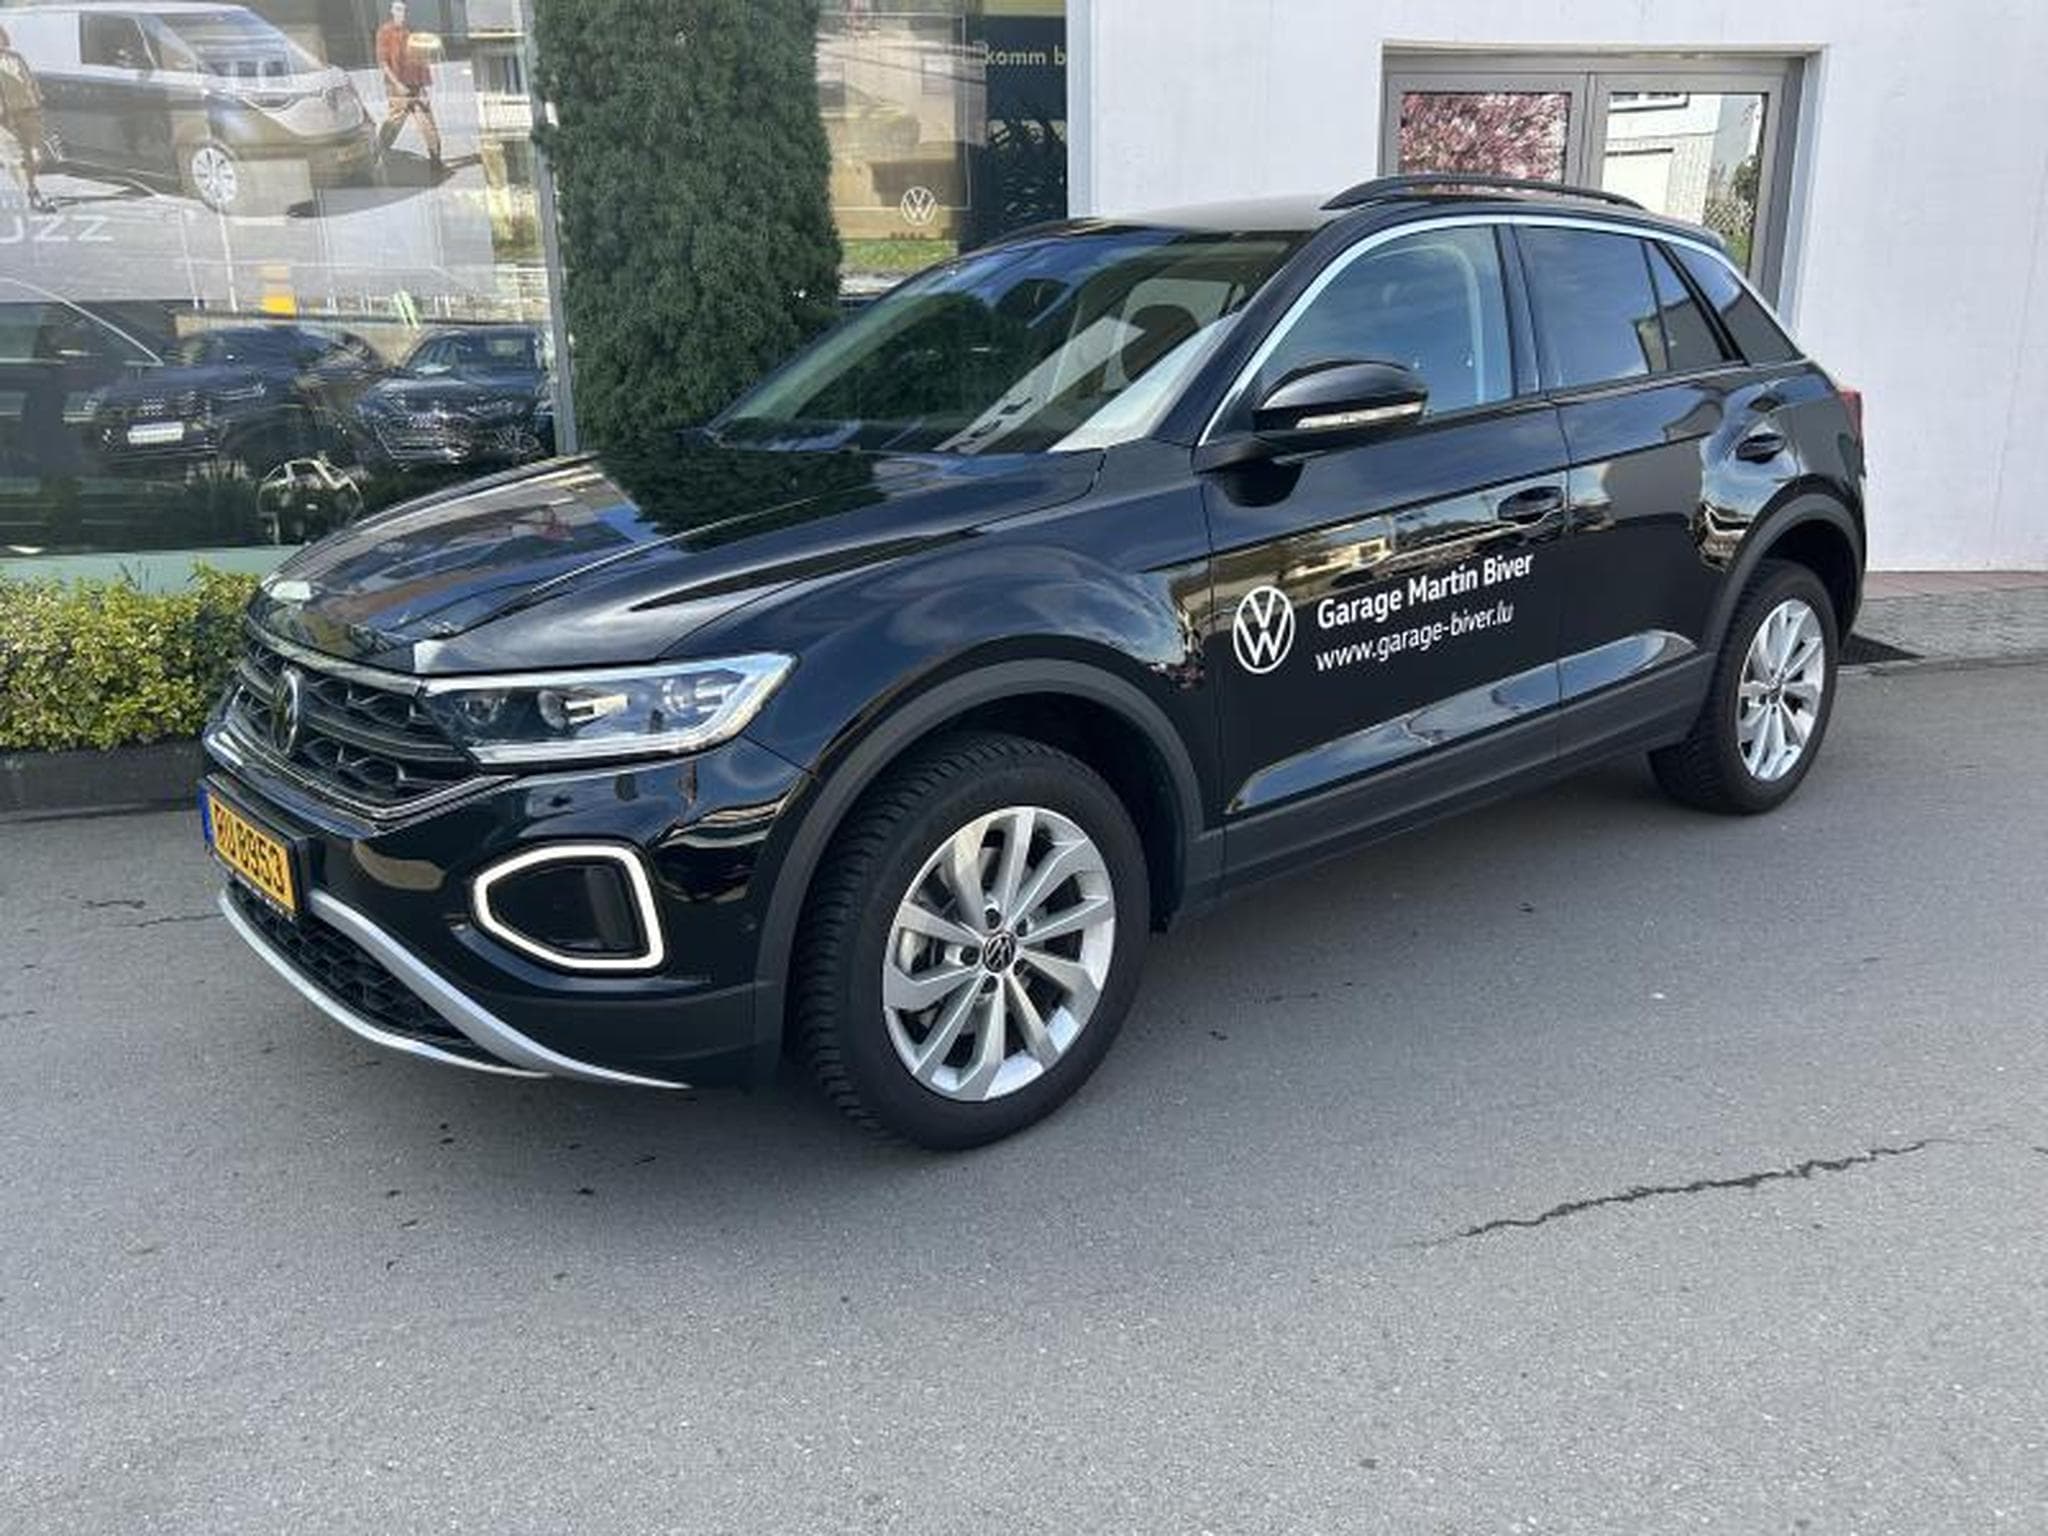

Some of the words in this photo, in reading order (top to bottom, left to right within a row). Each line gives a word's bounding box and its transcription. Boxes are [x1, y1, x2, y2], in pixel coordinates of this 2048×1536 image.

[1317, 589, 1403, 629] Garage
[1407, 563, 1479, 607] Martin
[1483, 553, 1534, 586] Biver
[1233, 585, 1296, 674] VW
[1315, 599, 1515, 671] www.garage-biver.lu
